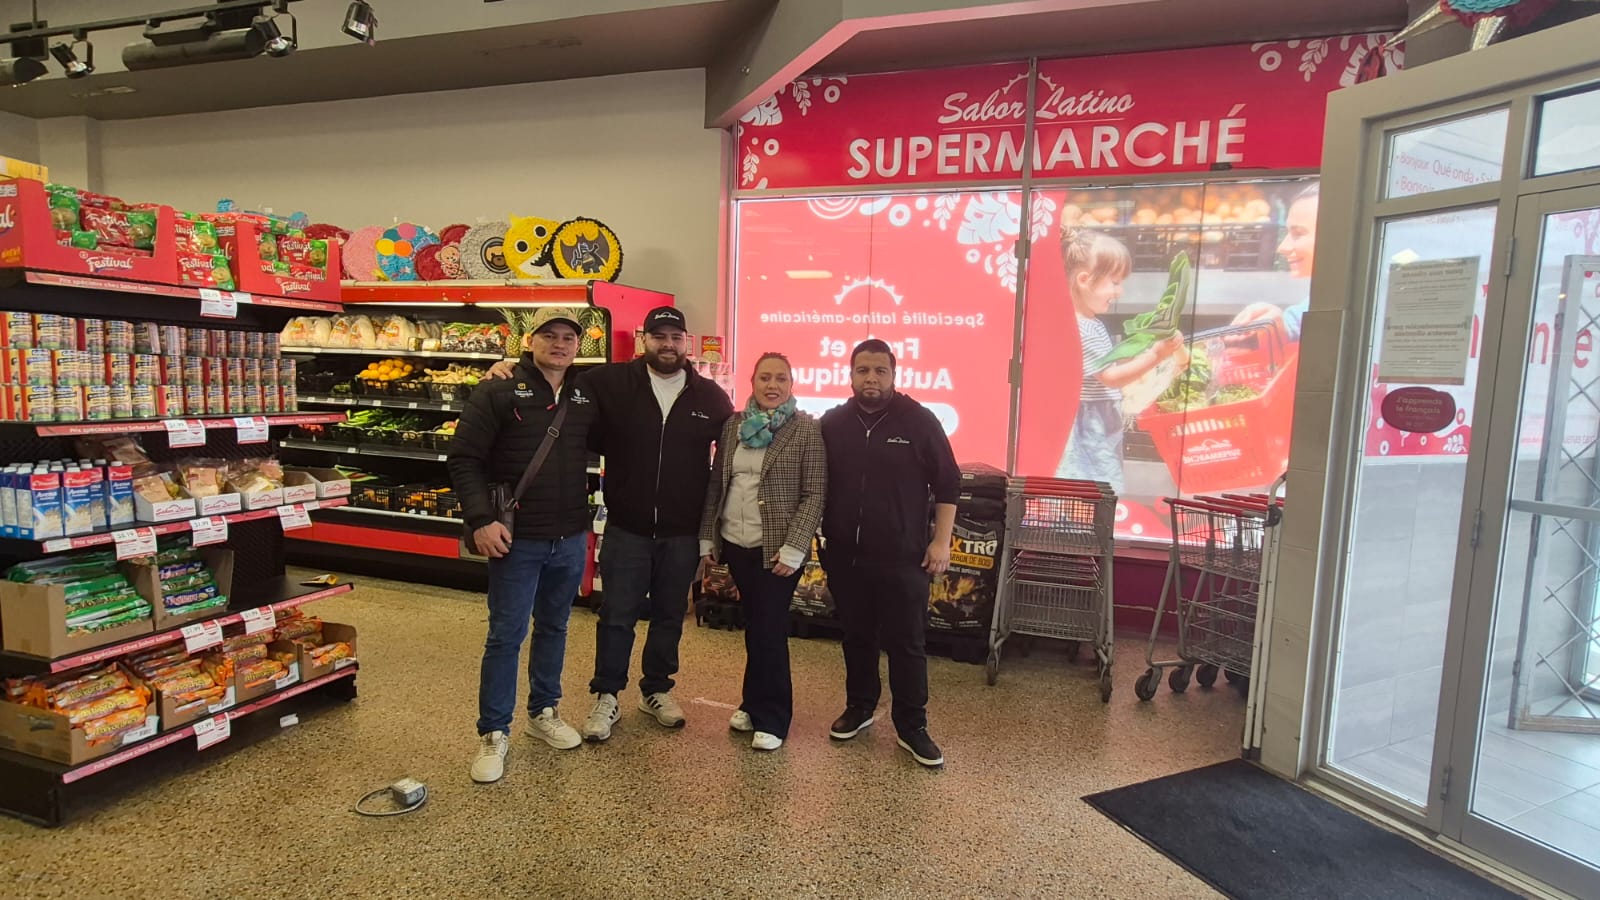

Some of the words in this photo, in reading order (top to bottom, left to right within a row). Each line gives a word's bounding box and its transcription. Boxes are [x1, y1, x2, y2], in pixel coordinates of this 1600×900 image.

[937, 89, 1026, 124] Sabor
[1035, 86, 1135, 119] Latino
[847, 104, 1246, 179] SUPERMARCHÉ
[86, 257, 134, 272] Festival
[178, 257, 215, 271] Festival
[280, 281, 311, 294] Festival
